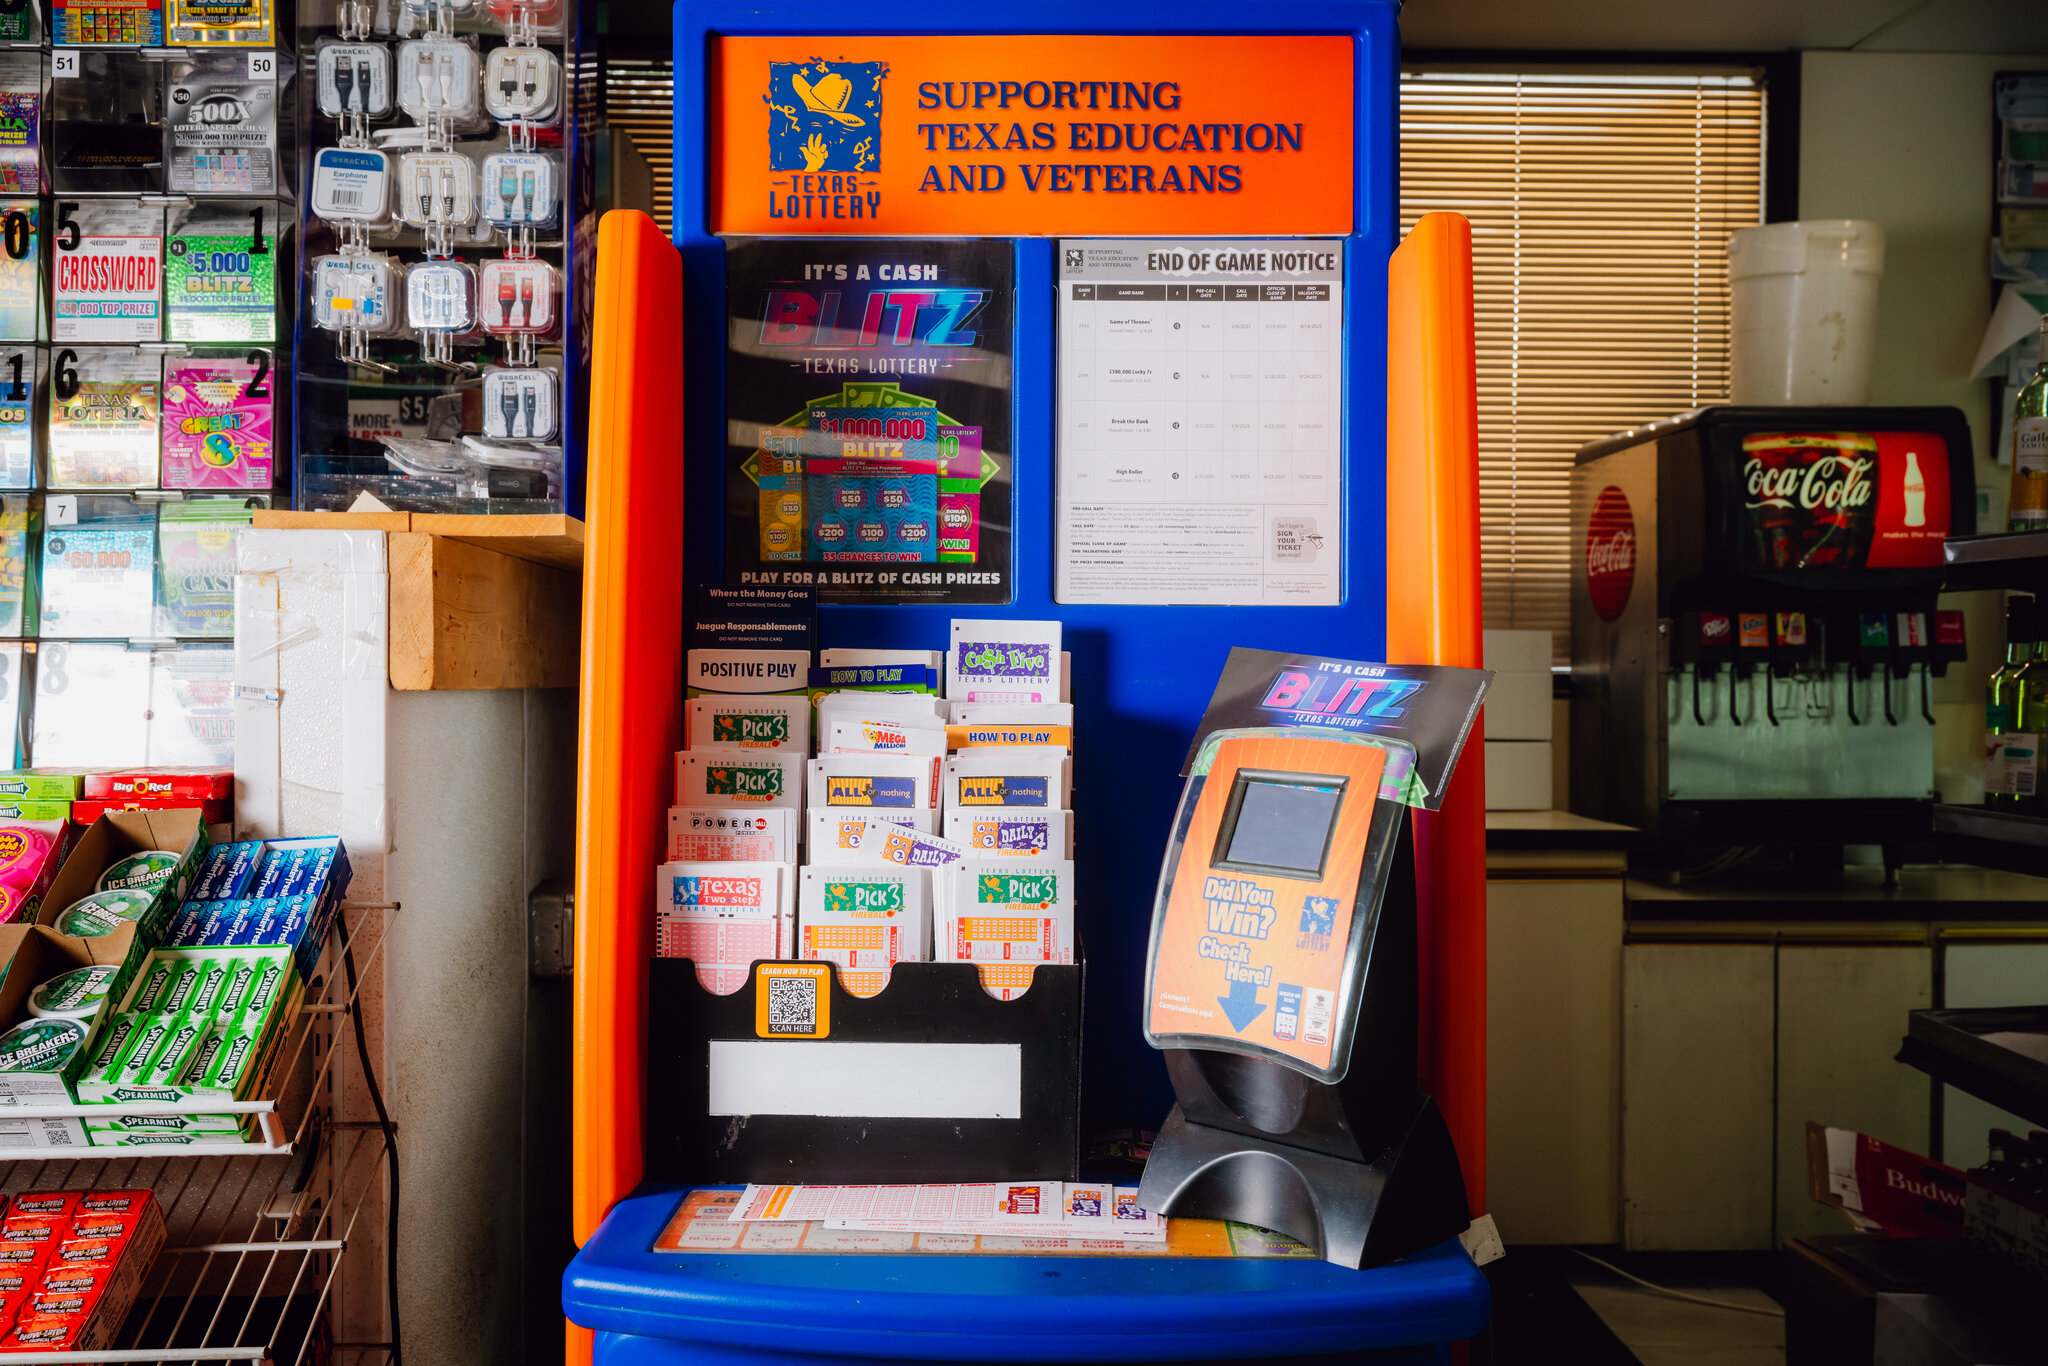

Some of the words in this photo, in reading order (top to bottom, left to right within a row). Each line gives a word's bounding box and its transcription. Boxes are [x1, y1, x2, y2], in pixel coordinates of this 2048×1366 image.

[56, 58, 73, 70] 51
[253, 60, 271, 72] 50
[173, 93, 190, 101] $50
[917, 81, 1181, 111] SUPPORTING
[188, 101, 252, 122] 500X
[917, 123, 1056, 151] TEXAS
[1068, 123, 1302, 152] EDUCATION
[333, 171, 368, 180] Earphone
[917, 164, 1006, 192] AND
[1022, 164, 1242, 192] VETERANS
[790, 175, 858, 194] TEXAS
[770, 191, 881, 219] LOTTERY
[57, 203, 80, 250] 5
[248, 206, 269, 254] 1
[186, 252, 250, 273] $5,000
[1148, 254, 1184, 270] END
[1188, 254, 1210, 271] OF
[1215, 254, 1266, 271] GAME
[1271, 254, 1335, 271] NOTICE
[60, 256, 156, 293] CROSSWORD
[804, 264, 848, 280] IT'S
[856, 265, 870, 280] A
[879, 264, 938, 281] CASH
[186, 276, 254, 292] BLITZ
[59, 303, 100, 316] $50,000
[102, 303, 120, 314] TOP
[123, 303, 154, 315] PRIZE!
[759, 290, 984, 346] BLITZ
[245, 349, 269, 398] 2
[804, 358, 859, 374] TEXAS
[869, 358, 938, 374] LOTTERY
[54, 349, 78, 401] 6
[79, 393, 131, 406] TEXAS
[58, 405, 151, 421] LOTERIA
[354, 413, 390, 427] MORE
[180, 412, 244, 435] GREAT
[820, 418, 925, 440] $1,000,000
[842, 442, 904, 458] BLITZ
[842, 495, 860, 503] $50
[58, 505, 66, 517] 7
[818, 529, 844, 537] $200
[861, 529, 883, 537] $100
[901, 529, 926, 537] $200
[64, 551, 131, 569] $60,000
[823, 553, 834, 561] 35
[836, 553, 880, 561] CHANCES
[882, 553, 896, 561] TO
[897, 553, 921, 561] WIN!
[741, 572, 778, 585] PLAY
[783, 572, 813, 585] FOR
[817, 572, 828, 584] A
[832, 572, 874, 585] BLITZ
[878, 572, 897, 585] OF
[902, 572, 942, 585] CASH
[947, 572, 1000, 585] PRIZES
[710, 589, 738, 597] Where
[741, 590, 755, 598] the
[757, 590, 786, 599] Money
[788, 590, 808, 598] Goes
[696, 622, 726, 631] Juegue
[727, 622, 806, 632] Responsablemente
[965, 644, 1006, 674] Ca$h
[1007, 650, 1044, 670] Five
[42, 646, 69, 694] 8
[700, 662, 764, 677] POSITIVE
[767, 664, 796, 678] PLAY
[831, 670, 857, 682] HOW
[860, 670, 874, 682] TO
[877, 669, 903, 681] PLAY
[1319, 662, 1339, 674] IT'S
[1343, 665, 1352, 674] A
[1354, 666, 1387, 677] CASH
[1262, 671, 1423, 718] BLITZ
[742, 718, 772, 737] PICK
[772, 716, 785, 739] 3
[1294, 714, 1323, 723] TEXAS
[1325, 716, 1363, 727] LOTTERY
[877, 731, 906, 744] MEGA
[969, 732, 998, 742] HOW
[1000, 732, 1017, 742] TO
[1020, 733, 1050, 743] PLAY
[113, 782, 134, 792] Big
[148, 782, 172, 792] Red
[832, 787, 862, 797] ALL
[880, 789, 910, 799] nothing
[1001, 827, 1035, 843] DAILY
[1031, 831, 1046, 849] 4
[224, 850, 249, 891] Winterfresh
[108, 880, 125, 890] ICE
[699, 879, 759, 896] Texas
[1009, 879, 1040, 897] PICK
[1040, 876, 1053, 901] 3
[1203, 876, 1236, 902] Did
[1239, 881, 1273, 907] You
[731, 896, 755, 904] Step
[1005, 902, 1040, 910] FIREBALL
[1208, 900, 1276, 940] Win?
[1198, 936, 1251, 965] Check
[1225, 961, 1272, 987] Here!
[1160, 992, 1190, 1003] ¿Ganaste?
[1159, 1001, 1198, 1016] Compruébalo
[16, 1028, 80, 1058] BREAKERS
[130, 1027, 163, 1068] SPEARMINT
[21, 1048, 58, 1066] MINTS
[119, 1089, 176, 1100] SPEARMINT
[125, 1117, 183, 1128] SPEARMINT
[131, 1136, 187, 1144] SPEARMINT
